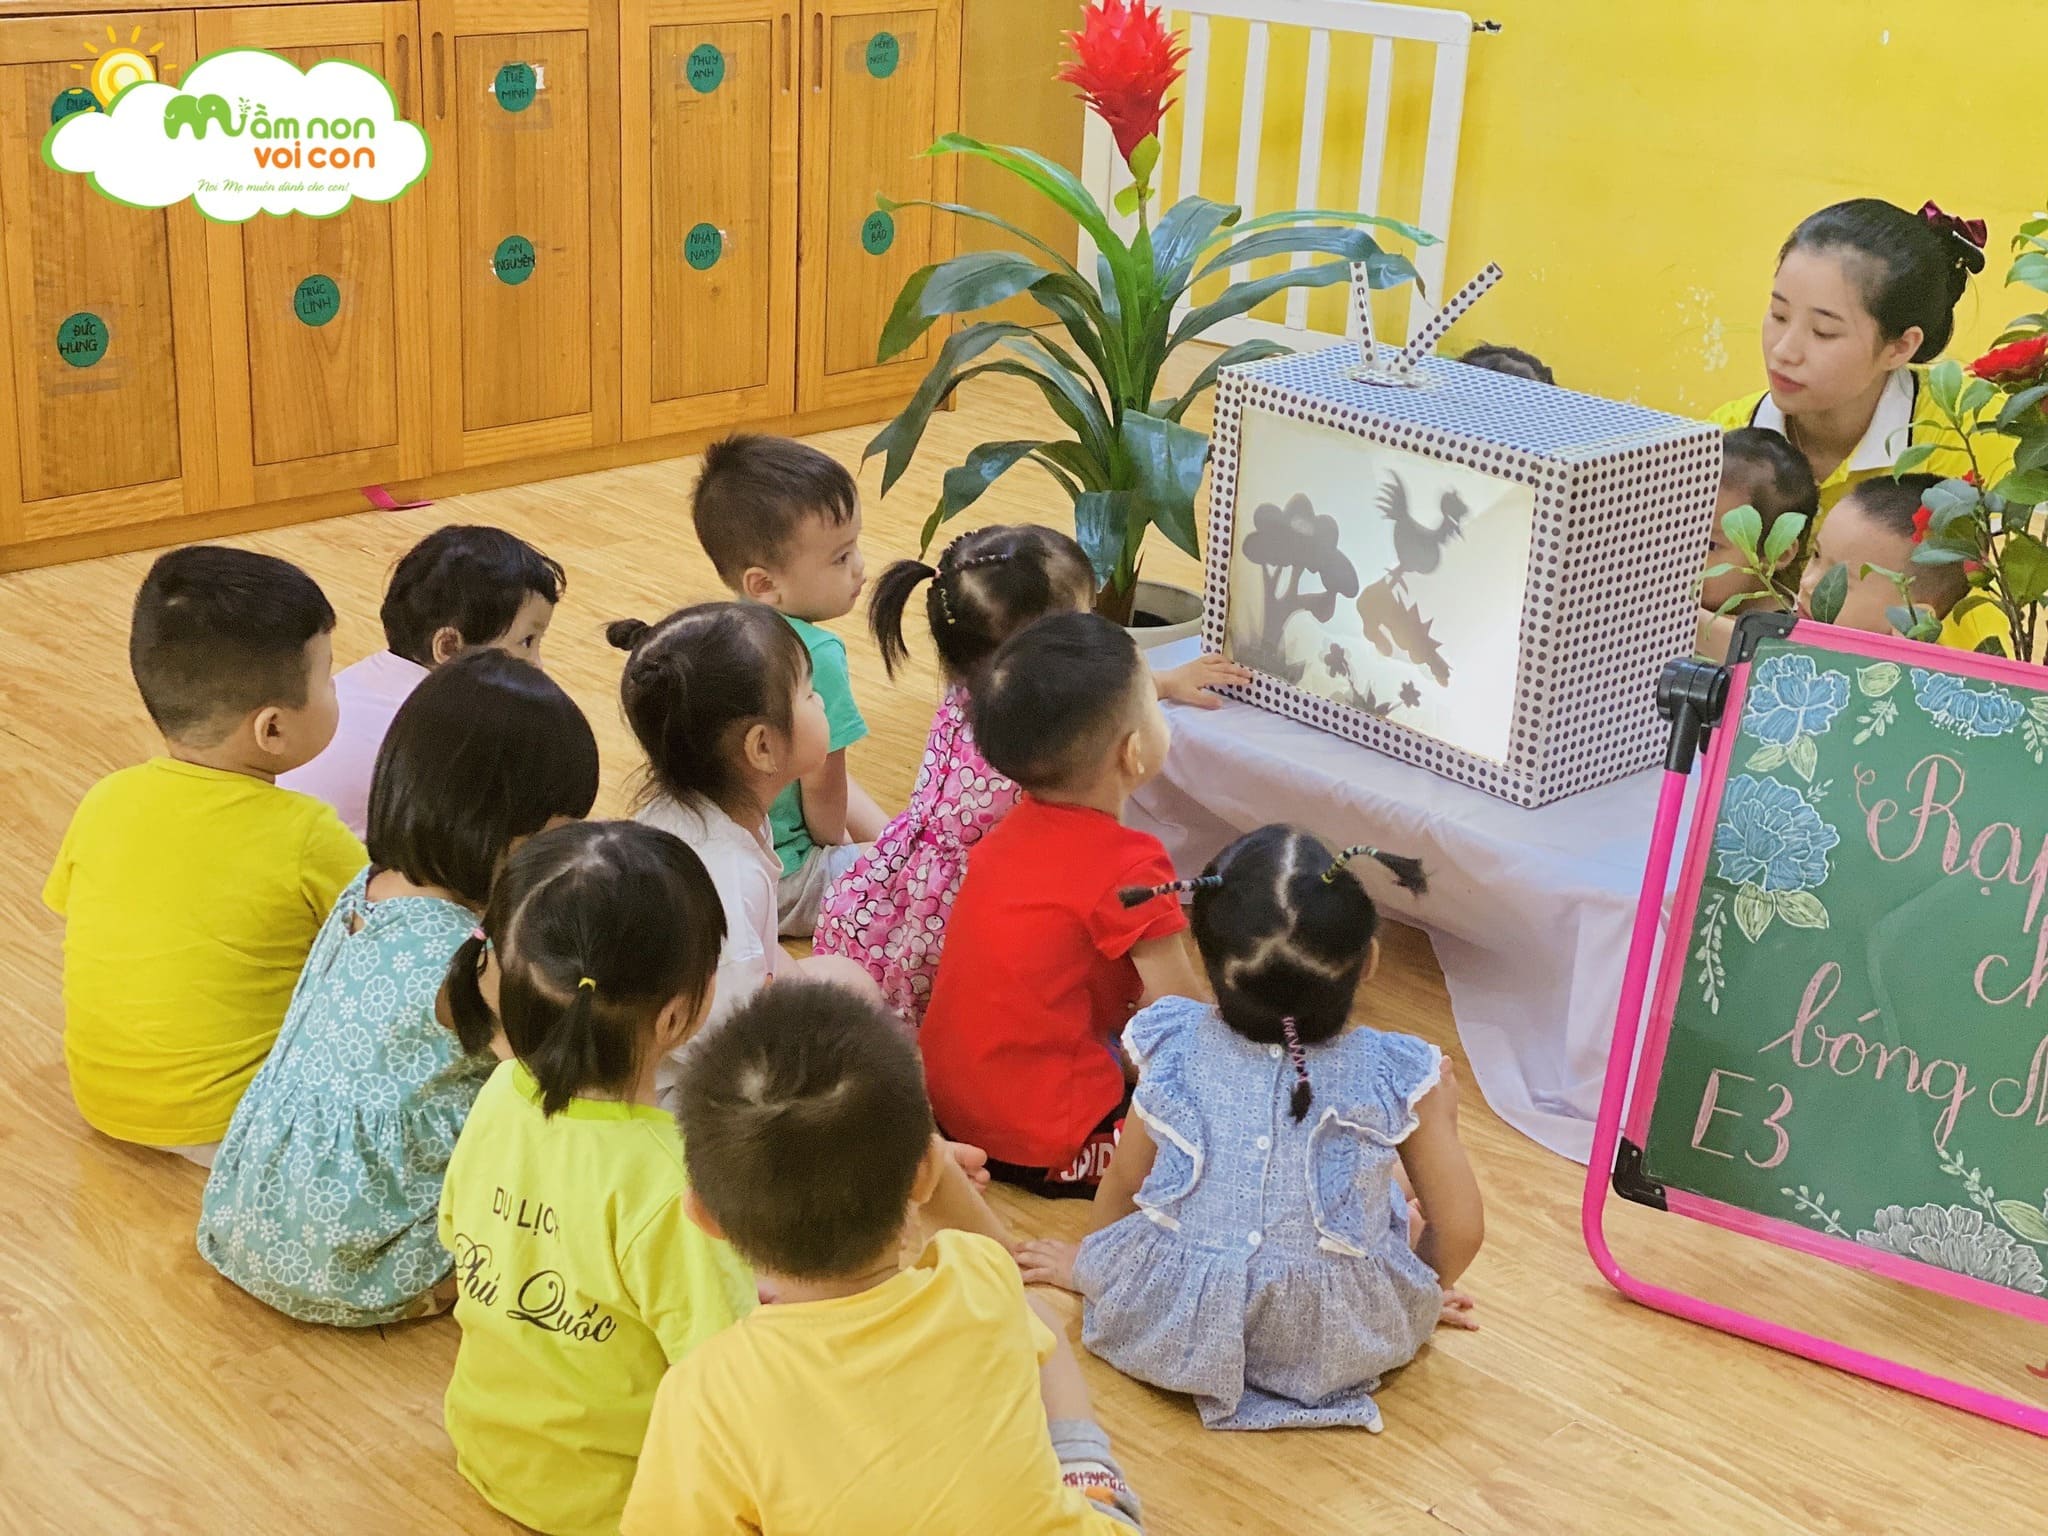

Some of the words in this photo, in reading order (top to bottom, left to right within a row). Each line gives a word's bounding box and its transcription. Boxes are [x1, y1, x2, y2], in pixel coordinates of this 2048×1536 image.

[501, 88, 529, 100] MINH
[302, 296, 332, 314] LINH
[1758, 962, 1977, 1149] bóng
[1690, 1067, 1794, 1169] E3
[493, 1186, 513, 1222] DU
[506, 1269, 618, 1343] Quốc
